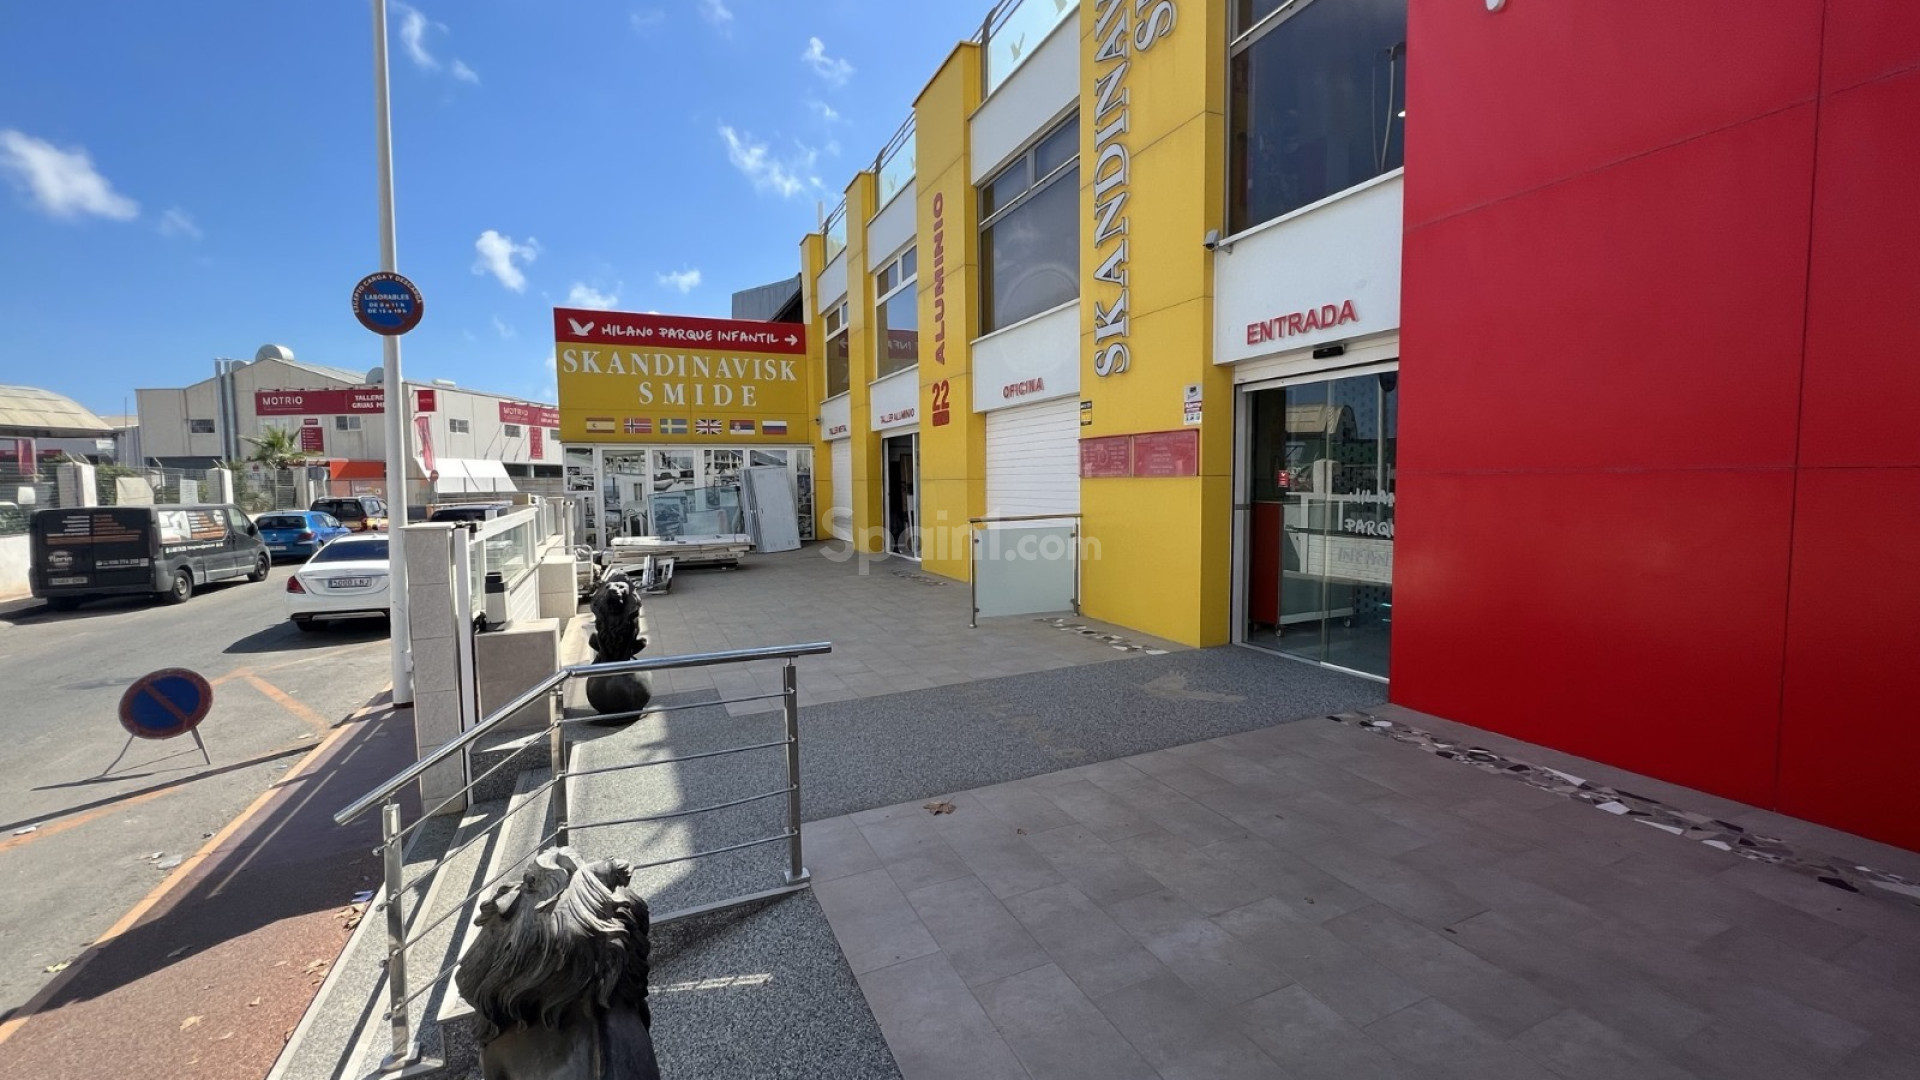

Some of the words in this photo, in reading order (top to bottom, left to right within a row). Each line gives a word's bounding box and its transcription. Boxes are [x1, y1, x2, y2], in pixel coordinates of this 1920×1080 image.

[933, 192, 945, 366] ALUMINIO
[364, 293, 410, 301] LABORABLES
[1246, 299, 1359, 345] ENTRADA
[658, 327, 712, 341] PARQUE
[718, 330, 779, 344] INFANTIL
[563, 349, 797, 381] SKANDINAVISK
[262, 396, 303, 405] MOTRIO
[639, 382, 757, 407] SMIDE
[932, 380, 950, 411] 22
[1003, 378, 1044, 399] OFICINA
